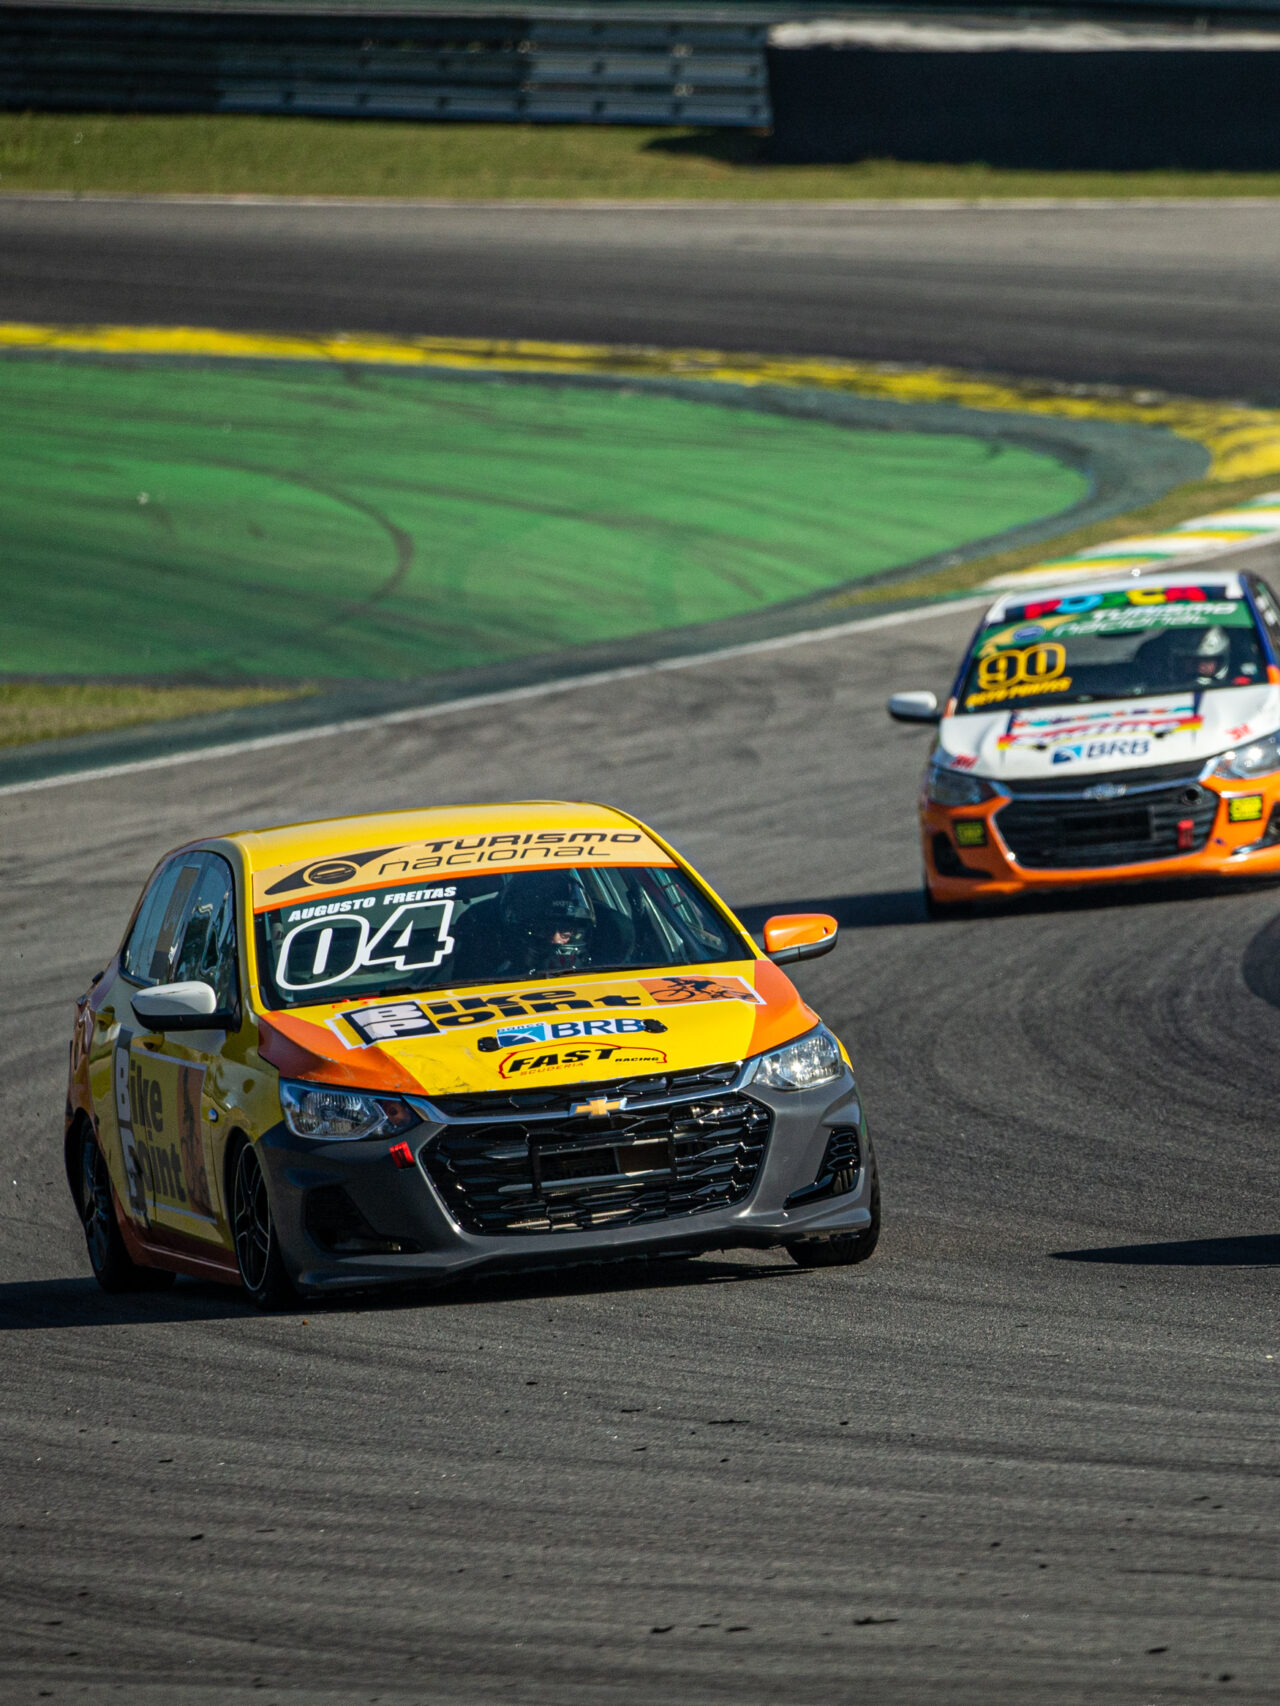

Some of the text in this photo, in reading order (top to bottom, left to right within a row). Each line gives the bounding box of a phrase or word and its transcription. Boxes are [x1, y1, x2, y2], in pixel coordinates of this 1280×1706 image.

[977, 641, 1067, 690] 90
[1086, 739, 1151, 759] BRB
[425, 832, 643, 853] TURISMO
[378, 845, 612, 876] nacional
[288, 886, 457, 922] AUGUSTO FREITAS
[276, 900, 455, 991] 04
[550, 1018, 647, 1039] BRB
[507, 1047, 622, 1074] FAST
[519, 1061, 585, 1077] SCUDERIA
